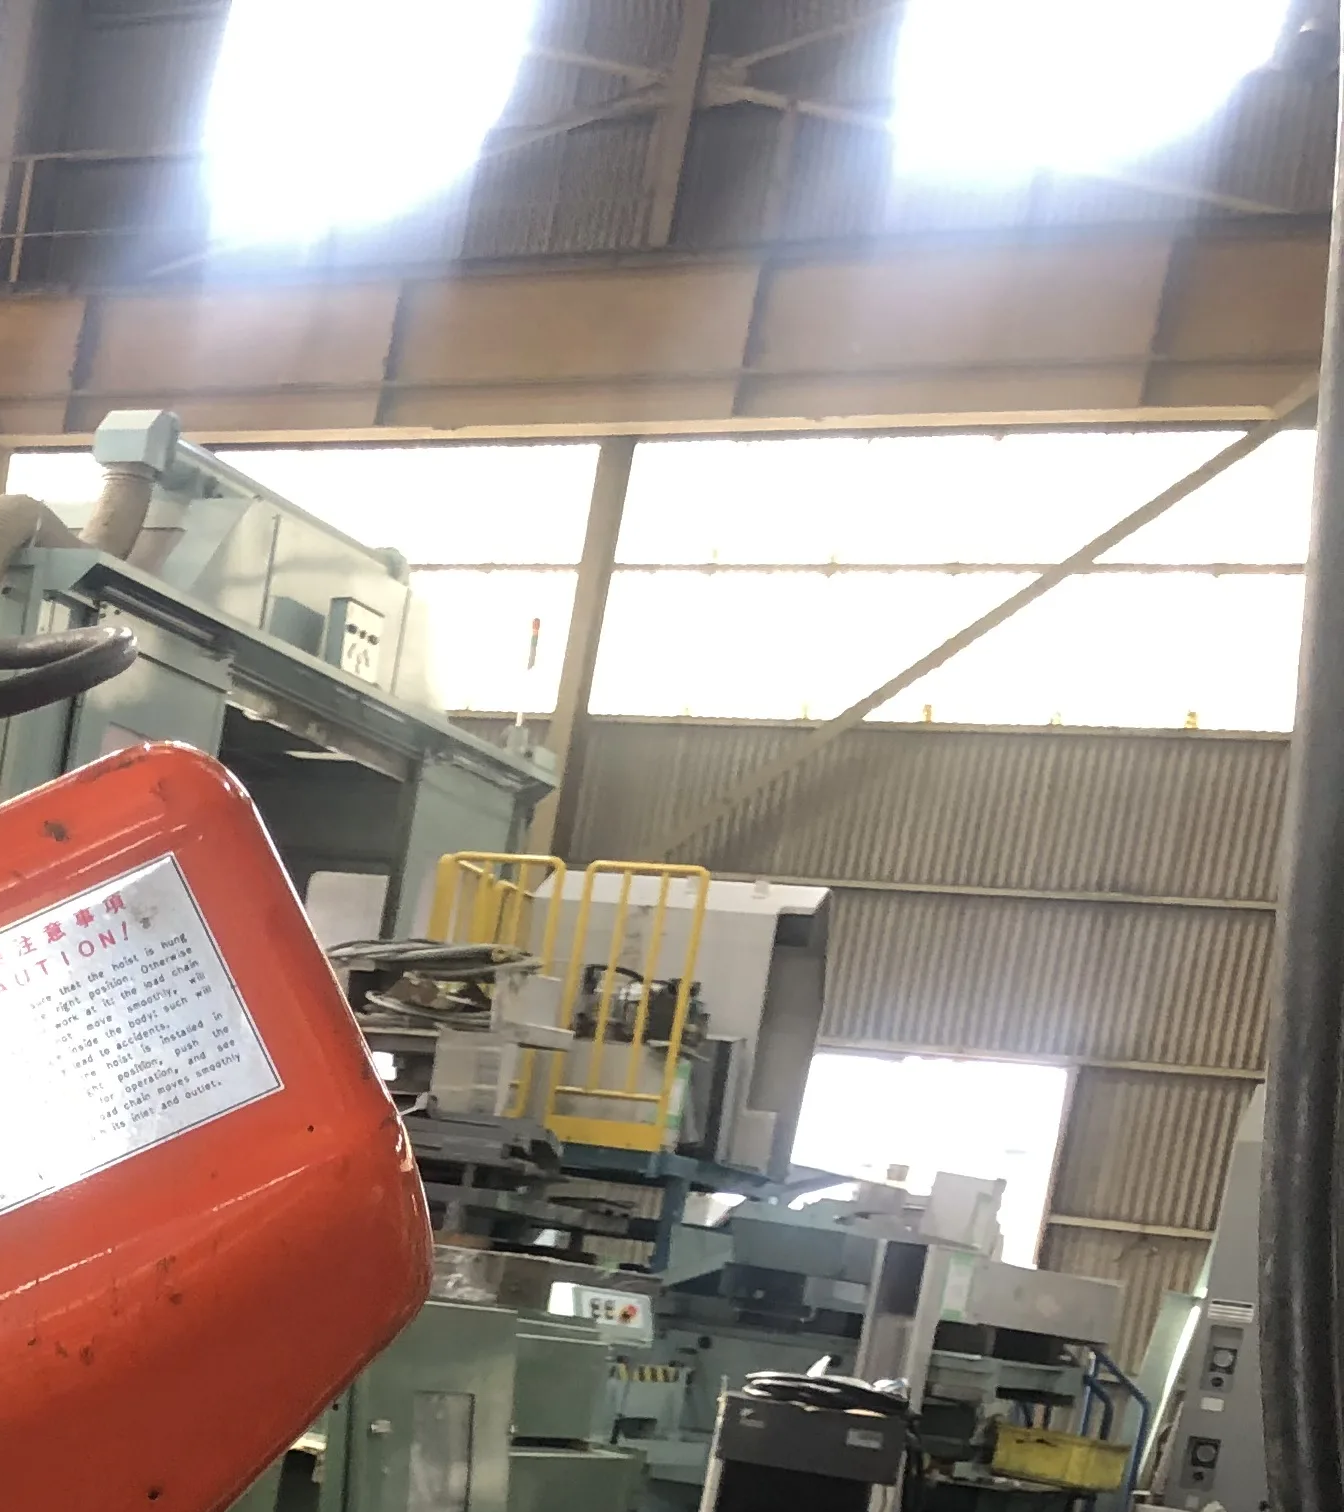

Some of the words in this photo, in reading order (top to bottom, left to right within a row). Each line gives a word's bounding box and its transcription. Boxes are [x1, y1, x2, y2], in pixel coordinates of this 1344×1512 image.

[55, 995, 82, 1013] right
[140, 946, 193, 975] Otherwise
[58, 980, 82, 996] that
[87, 970, 105, 983] the
[110, 953, 140, 972] hoist
[143, 947, 155, 957] is
[160, 932, 188, 950] hung
[54, 1014, 80, 1030] work
[85, 1005, 97, 1016] at
[119, 986, 138, 1001] the
[142, 973, 166, 989] load
[171, 959, 200, 977] chain
[86, 1014, 113, 1032] move
[188, 972, 206, 985] will
[104, 1026, 123, 1039] the
[162, 995, 189, 1014] such
[194, 984, 212, 1000] will
[98, 1047, 111, 1058] to
[105, 1052, 134, 1070] hoist
[139, 1042, 152, 1054] is
[158, 1019, 204, 1046] installed
[211, 1011, 224, 1022] in
[117, 1058, 164, 1084] position,
[174, 1039, 200, 1058] push
[211, 1025, 230, 1039] the
[124, 1066, 179, 1094] operation,
[187, 1051, 207, 1066] and
[216, 1038, 236, 1053] see
[100, 1106, 119, 1121] oad
[123, 1092, 151, 1111] chain
[156, 1075, 191, 1096] moves
[195, 1052, 241, 1078] smoothly
[111, 1120, 127, 1131] its
[130, 1106, 156, 1123] inlet
[161, 1094, 180, 1111] and
[184, 1080, 223, 1100] outlet.
